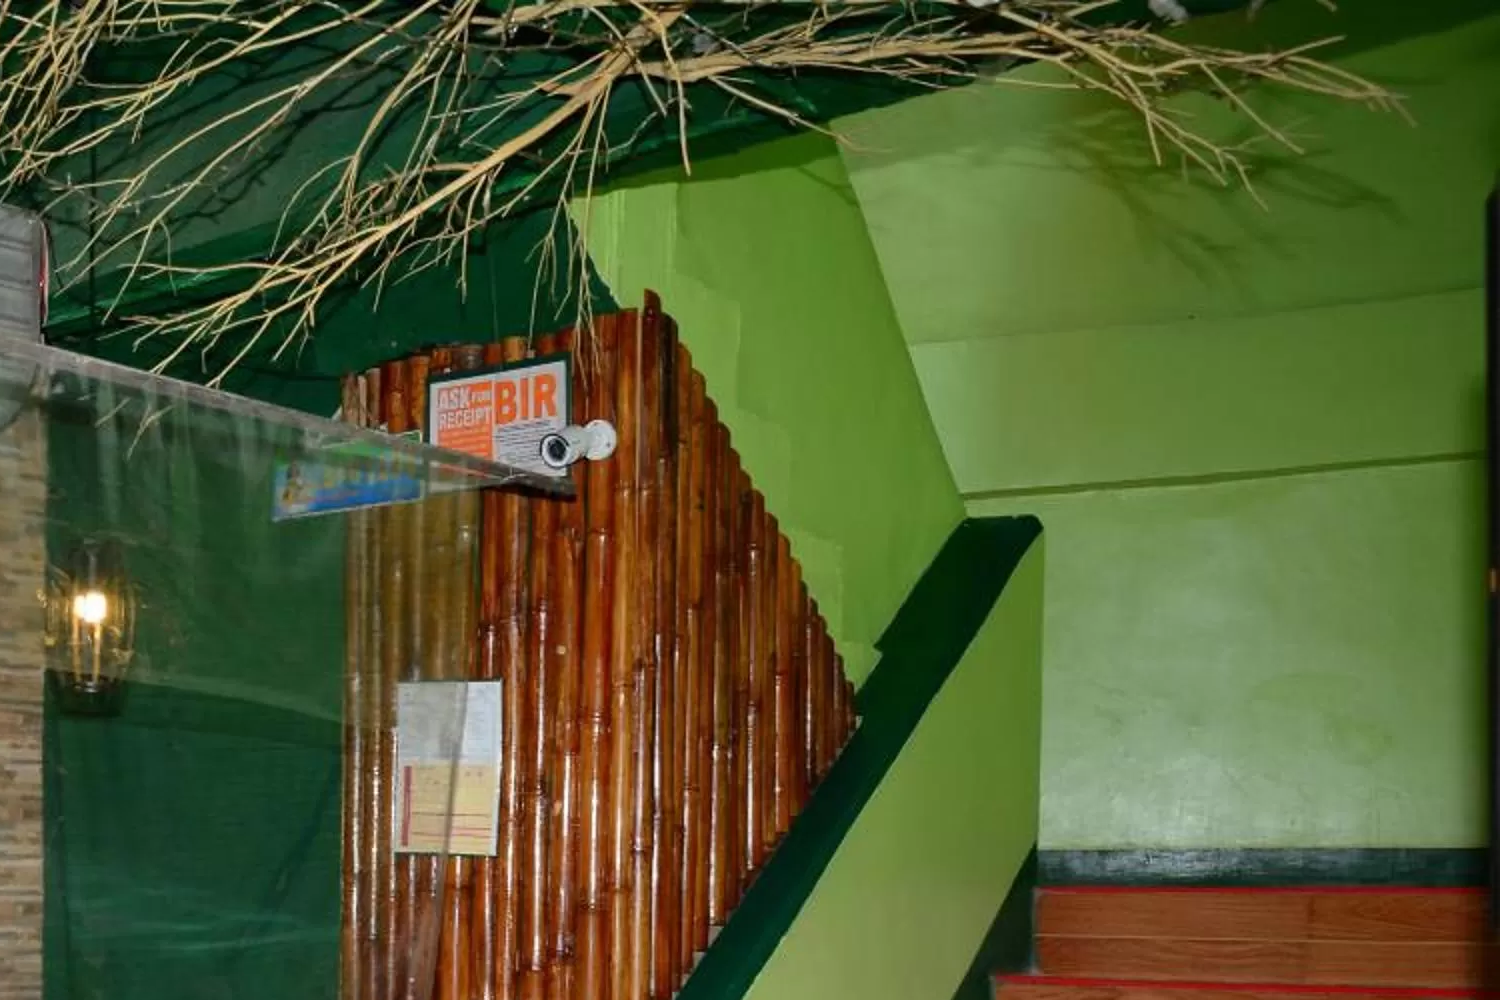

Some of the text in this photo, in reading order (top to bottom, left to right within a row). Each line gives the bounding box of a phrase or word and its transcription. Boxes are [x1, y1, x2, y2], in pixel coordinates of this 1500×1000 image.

[438, 385, 469, 409] ASK
[495, 373, 557, 424] BIR
[438, 406, 492, 430] RECEIPT
